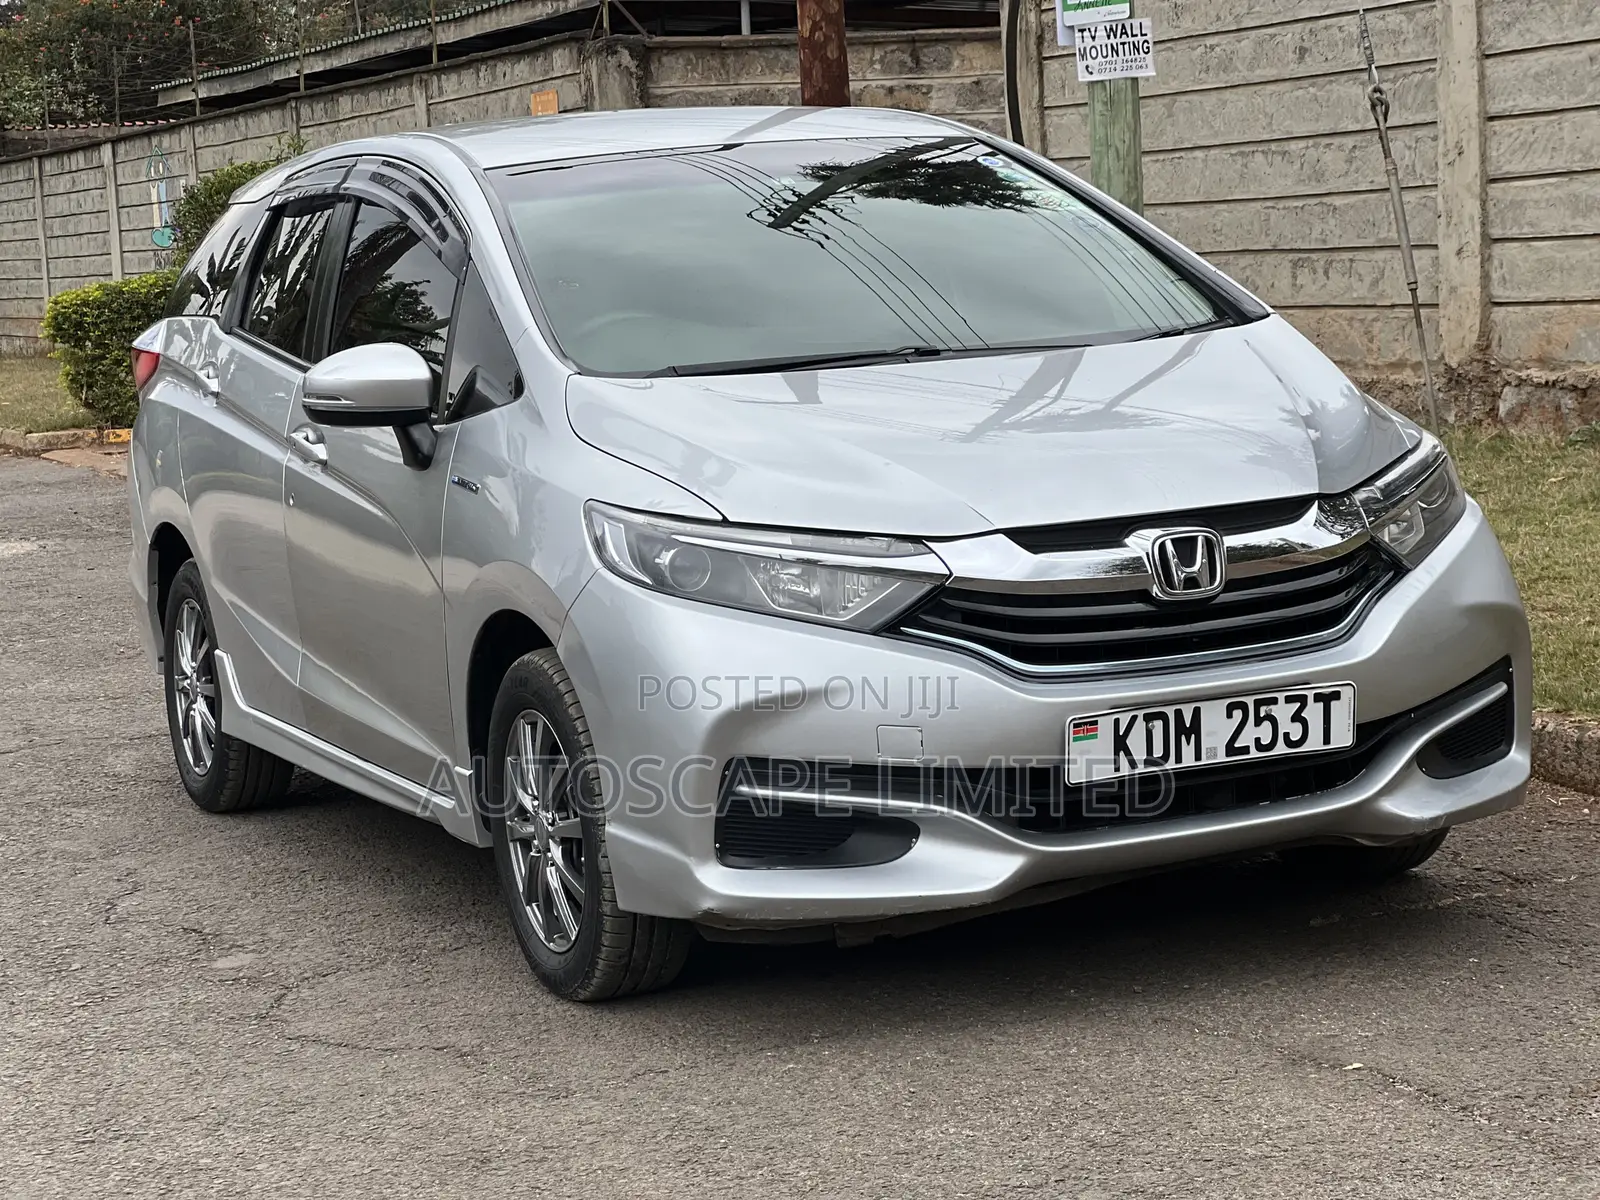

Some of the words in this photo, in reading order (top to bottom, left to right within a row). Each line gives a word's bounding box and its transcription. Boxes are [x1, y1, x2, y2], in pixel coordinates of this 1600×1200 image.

[1077, 27, 1098, 43] TV
[1103, 22, 1148, 40] WALL
[1078, 40, 1151, 62] MOUNTING
[1097, 66, 1117, 74] 0714
[1112, 705, 1202, 773] KDM
[1225, 689, 1342, 757] 253T
